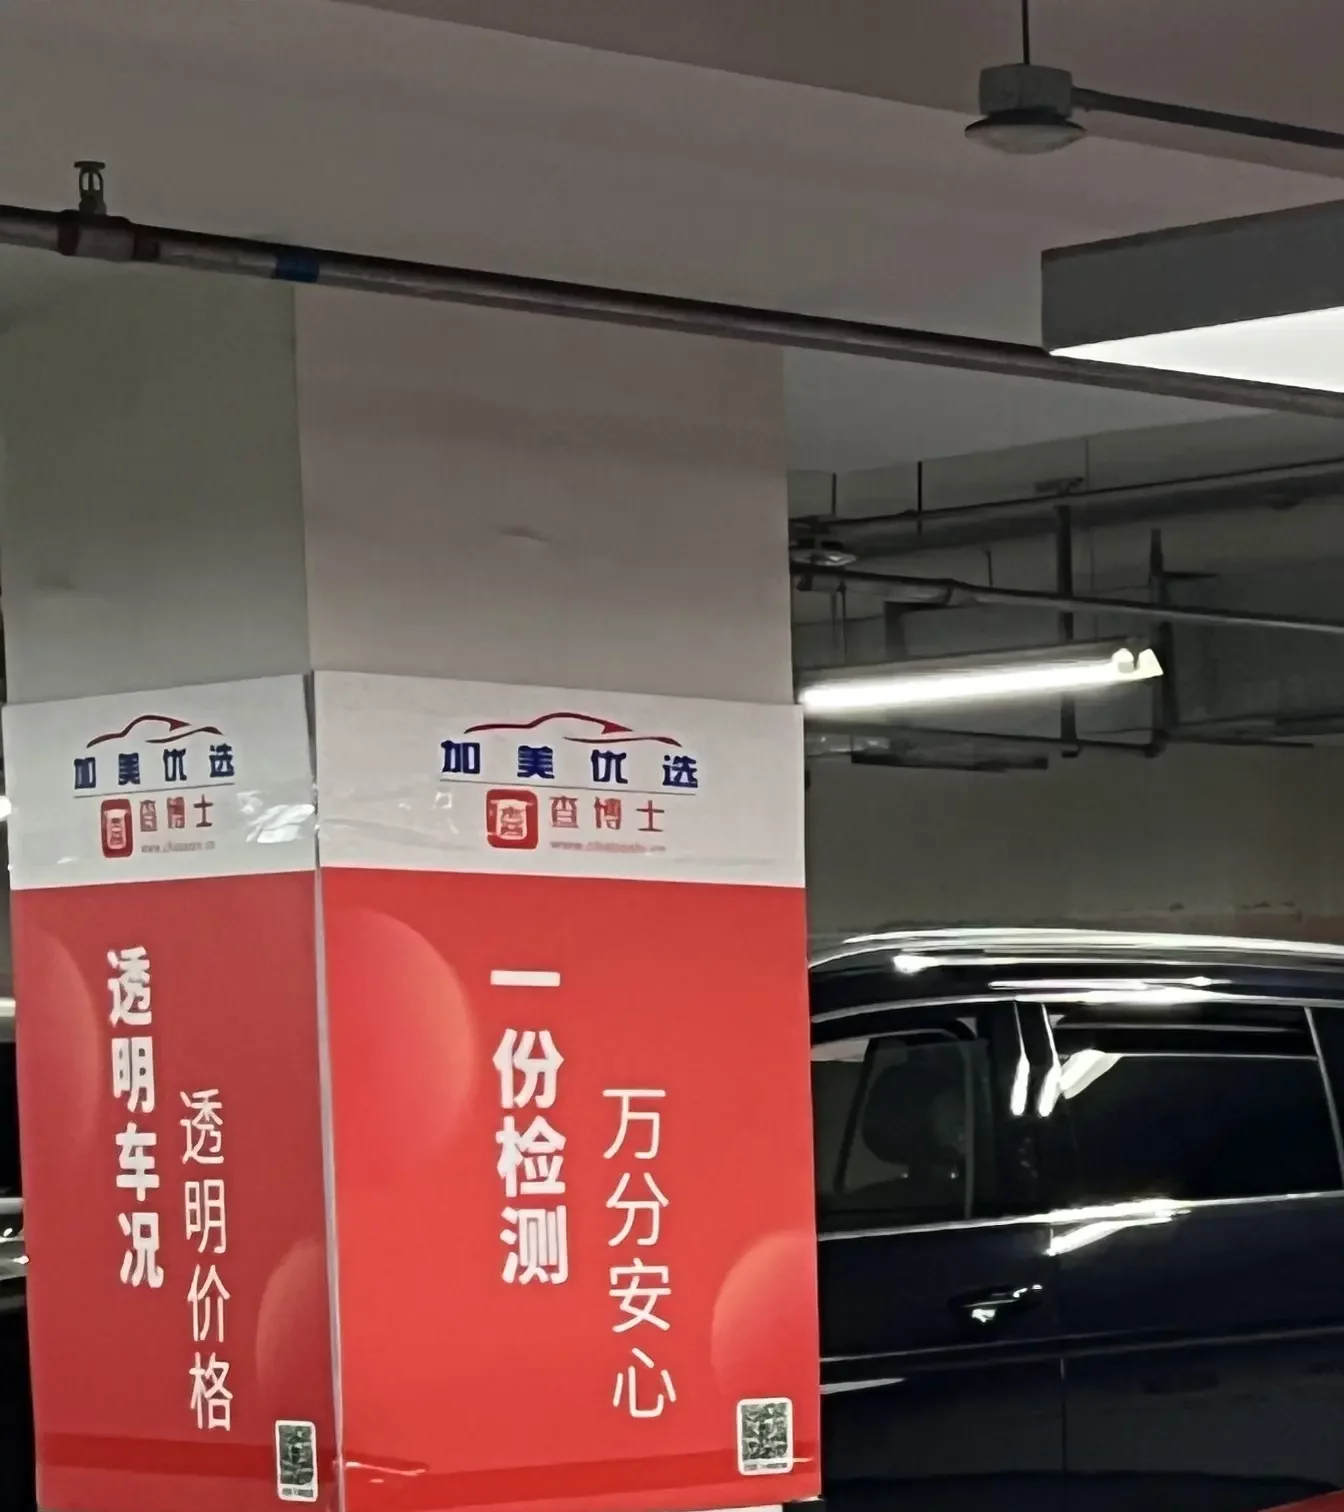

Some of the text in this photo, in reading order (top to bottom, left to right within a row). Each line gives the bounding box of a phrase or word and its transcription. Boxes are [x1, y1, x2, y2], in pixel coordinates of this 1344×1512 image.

[73, 743, 236, 790] 加美优选
[440, 740, 699, 789] 加美优选
[549, 795, 666, 833] 查博士
[106, 946, 164, 1289] 透明车况
[179, 1088, 233, 1432] 透明价格
[490, 969, 568, 1286] 一份检测
[603, 1088, 677, 1420] 万分安心
